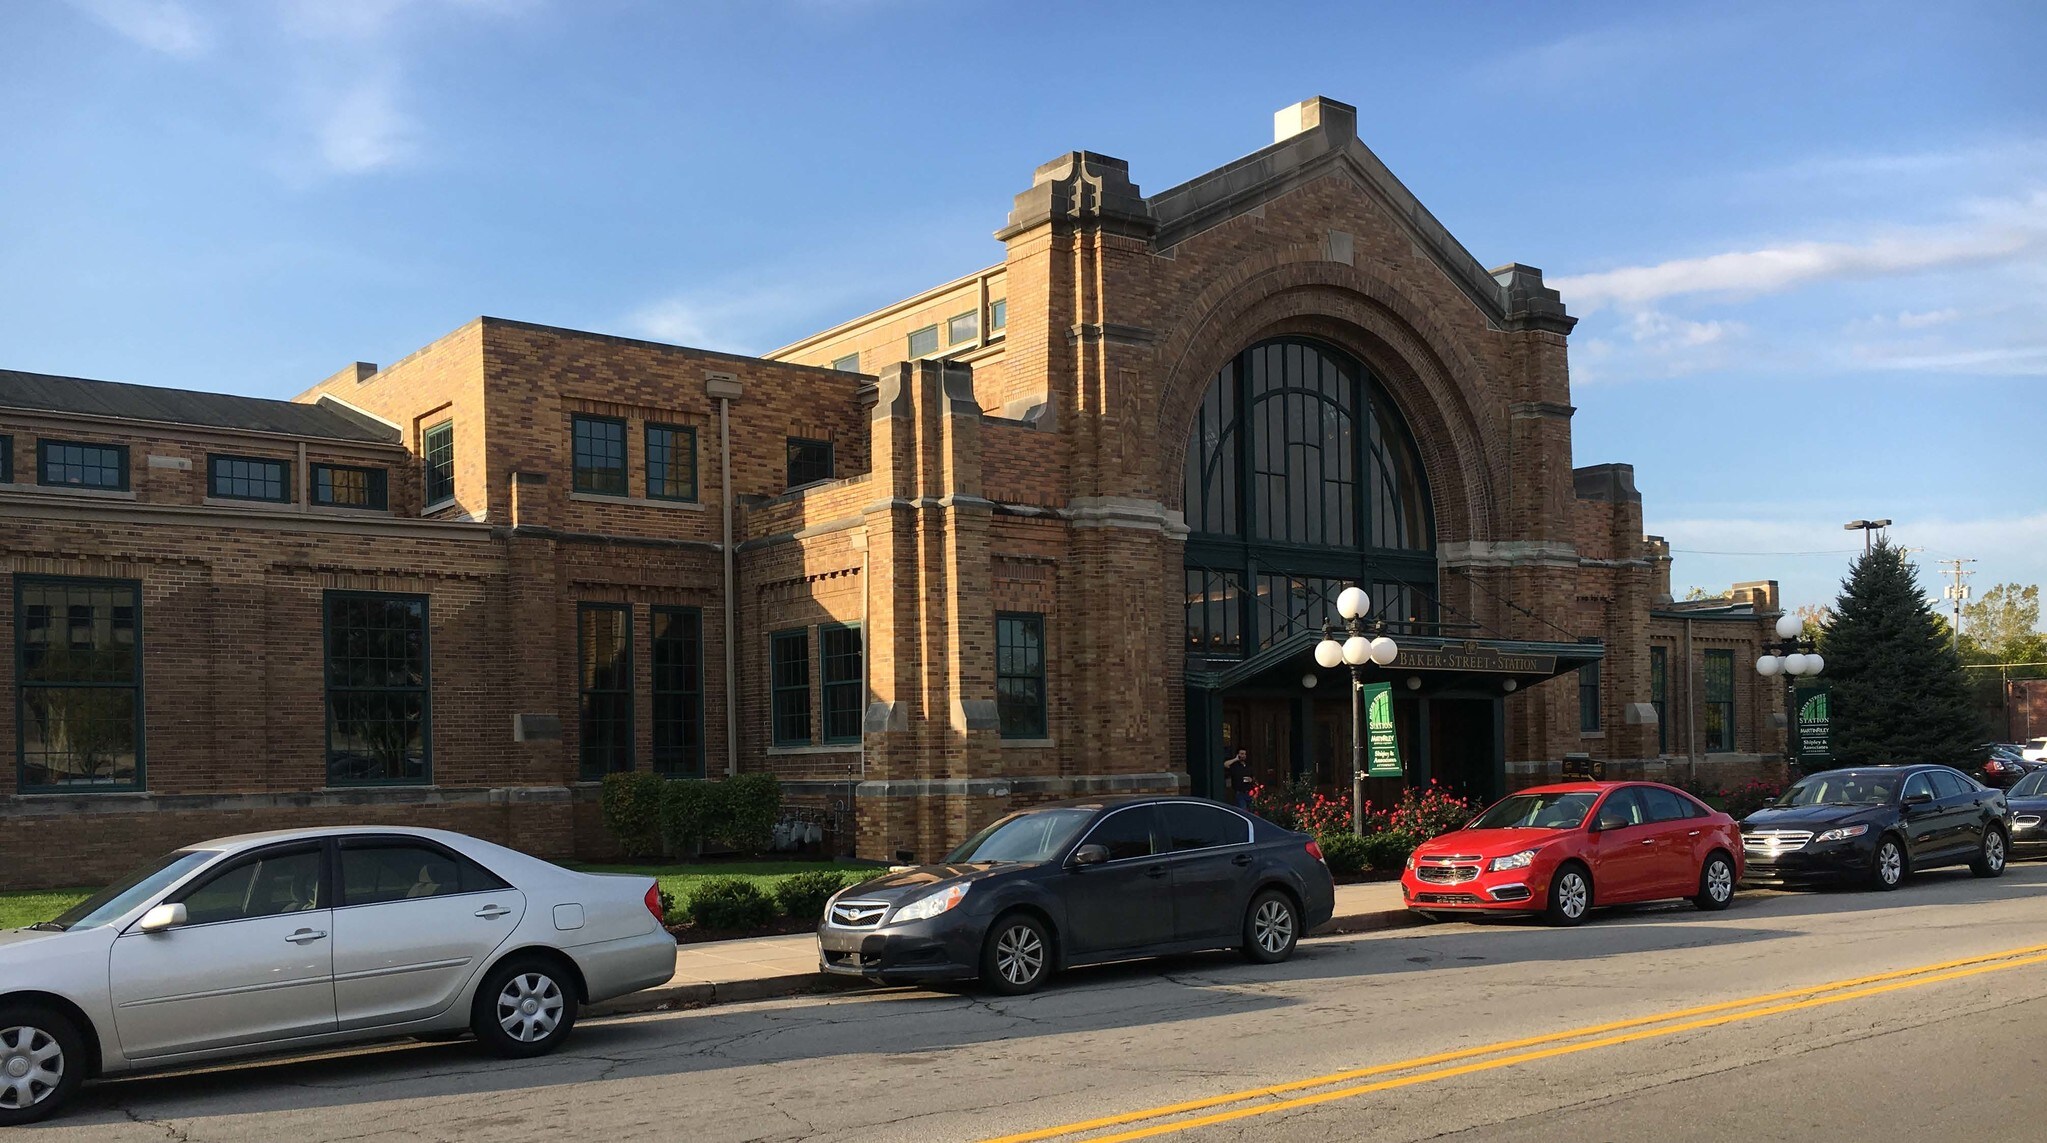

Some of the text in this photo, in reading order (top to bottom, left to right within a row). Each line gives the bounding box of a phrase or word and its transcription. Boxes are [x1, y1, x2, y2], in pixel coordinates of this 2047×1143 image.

[1400, 652, 1537, 670] BAKER STREET STATION
